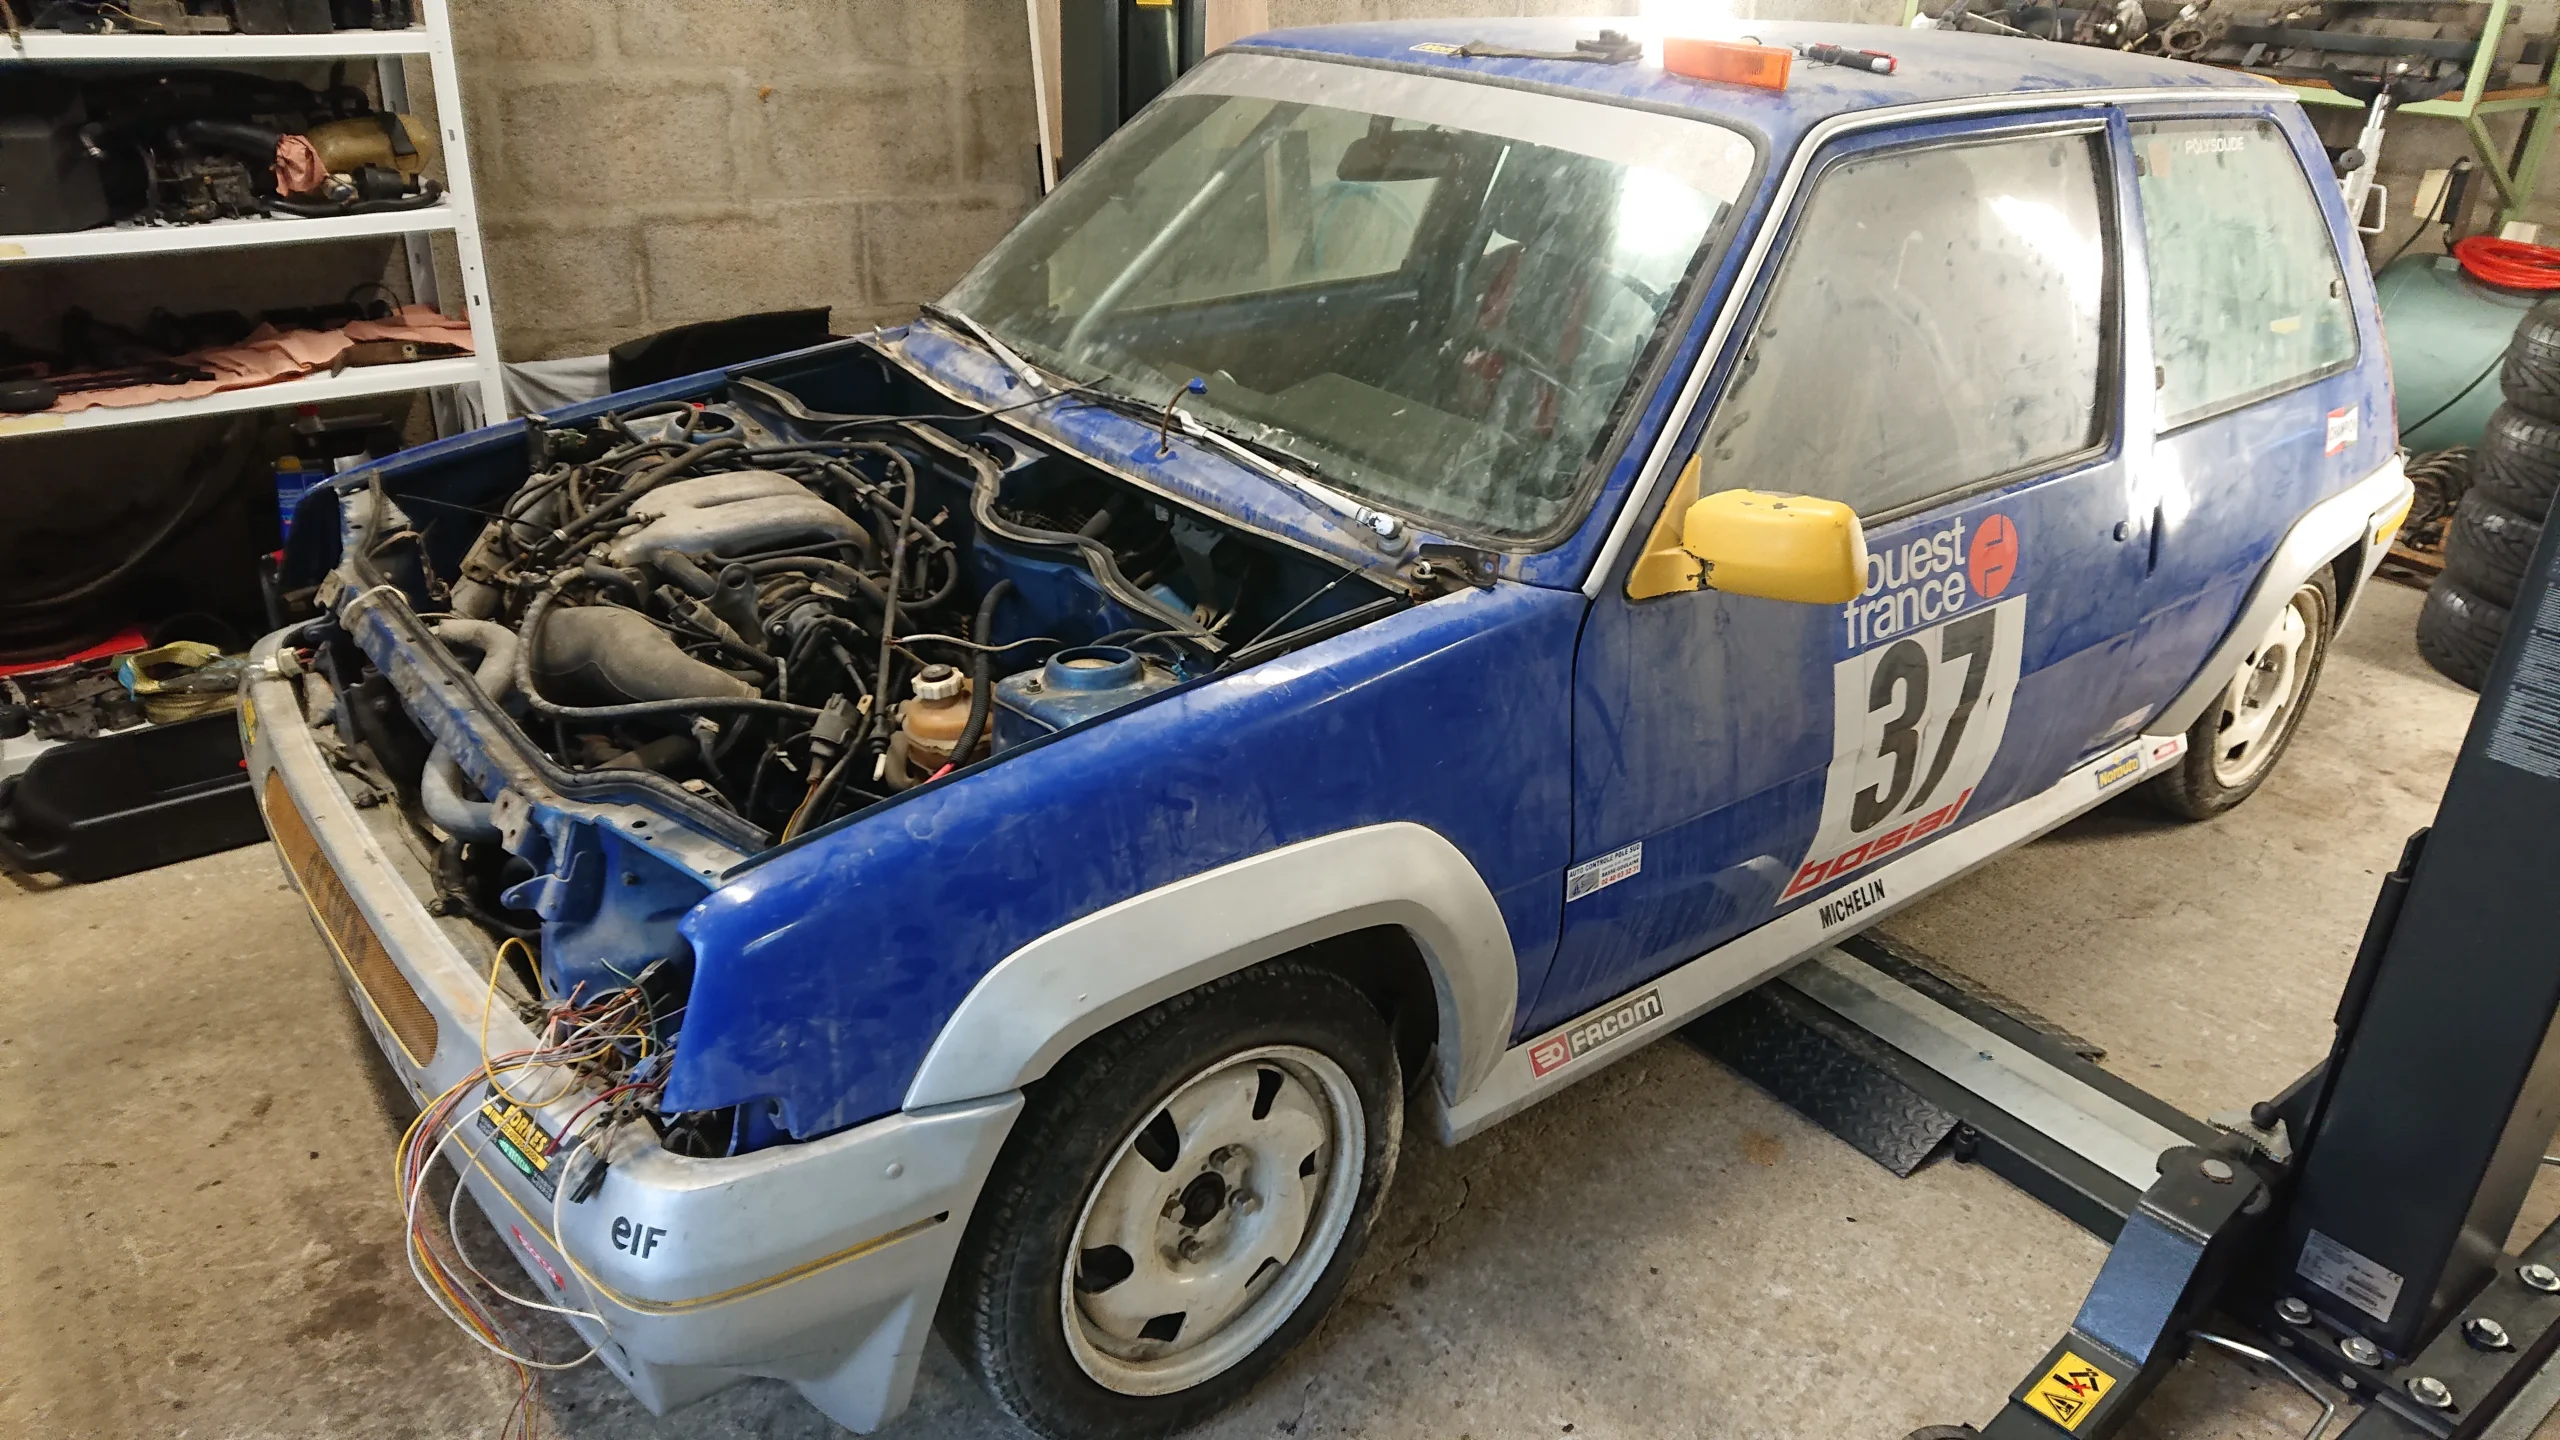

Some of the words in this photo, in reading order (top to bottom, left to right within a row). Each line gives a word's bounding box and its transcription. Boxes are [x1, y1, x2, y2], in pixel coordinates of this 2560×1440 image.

[1843, 572, 1966, 649] france
[1850, 607, 1997, 833] 37
[1569, 867, 1584, 877] AUTO
[1782, 787, 1974, 900] bosal
[1819, 879, 1885, 929] MICHELIN
[1571, 995, 1659, 1053] FACOM
